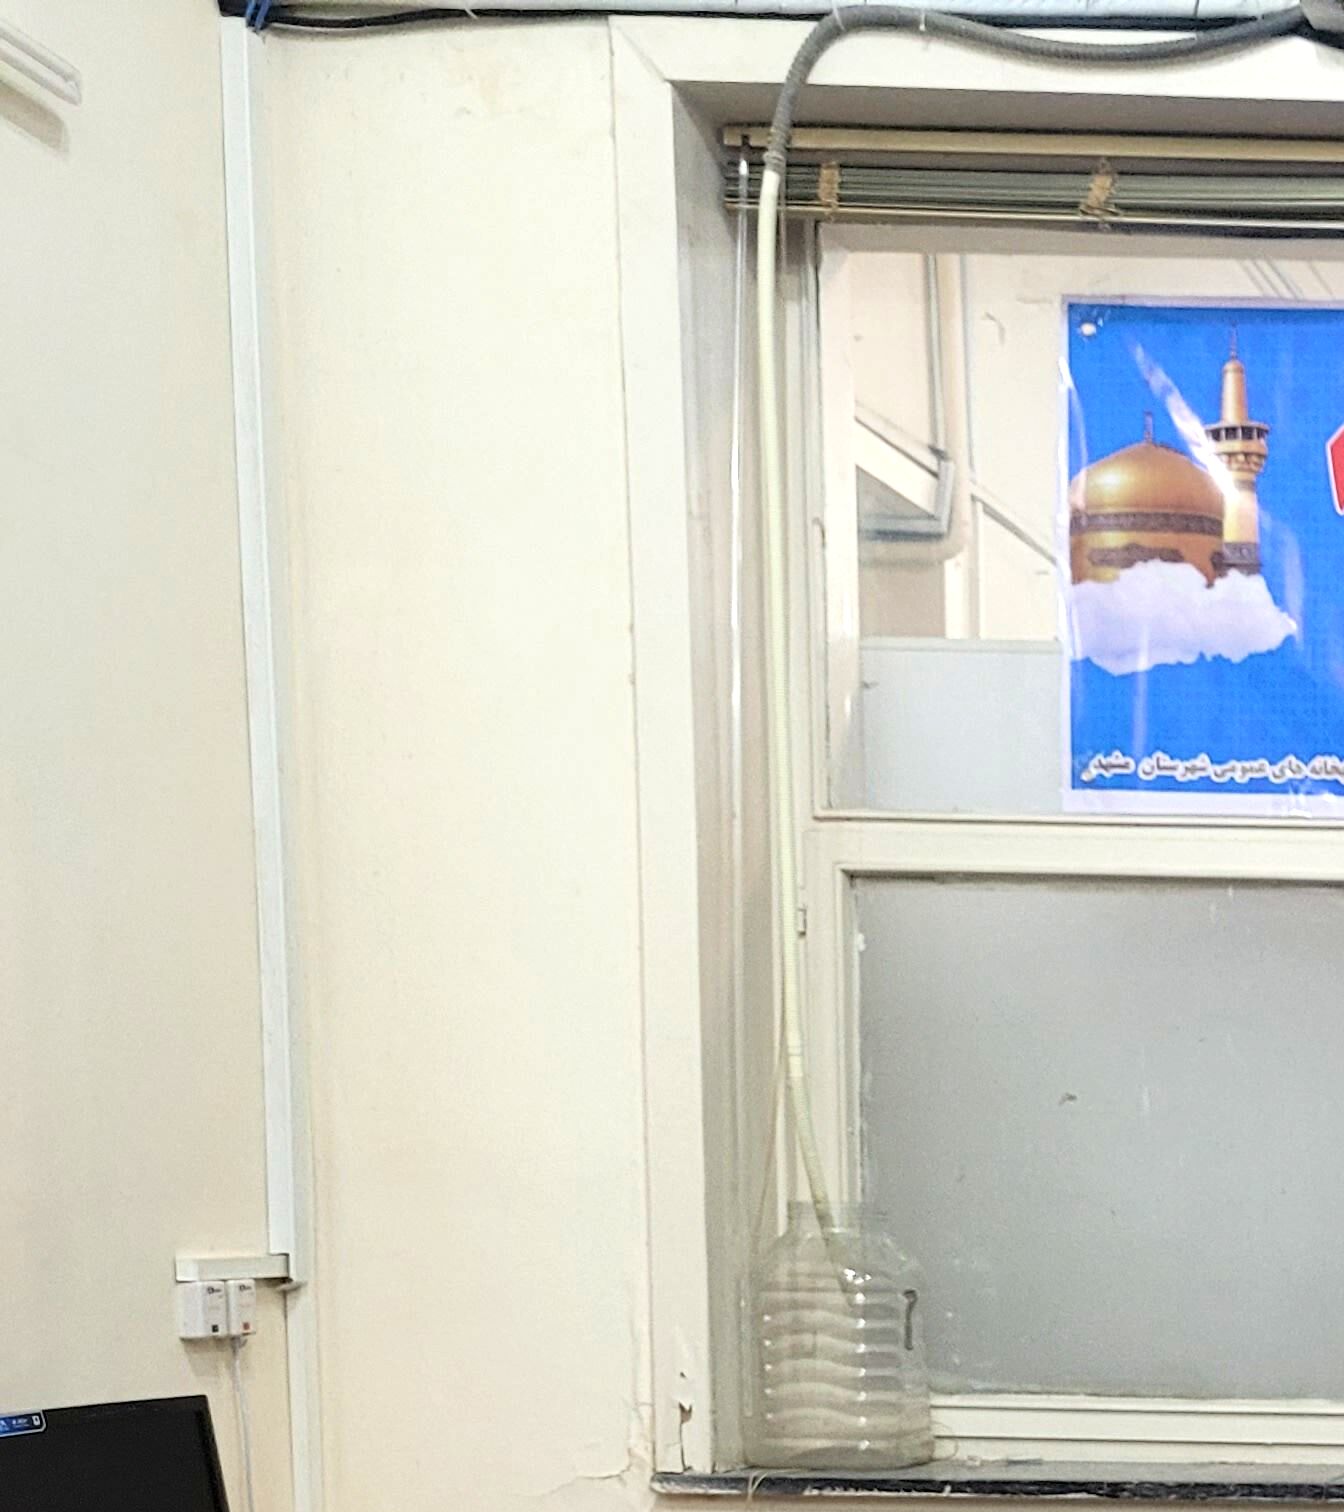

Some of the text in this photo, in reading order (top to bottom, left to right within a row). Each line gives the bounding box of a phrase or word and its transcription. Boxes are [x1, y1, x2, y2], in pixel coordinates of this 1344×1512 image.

[1092, 750, 1135, 775] مشهد
[1138, 752, 1213, 783] شهرستان
[1213, 761, 1268, 784] عمومی
